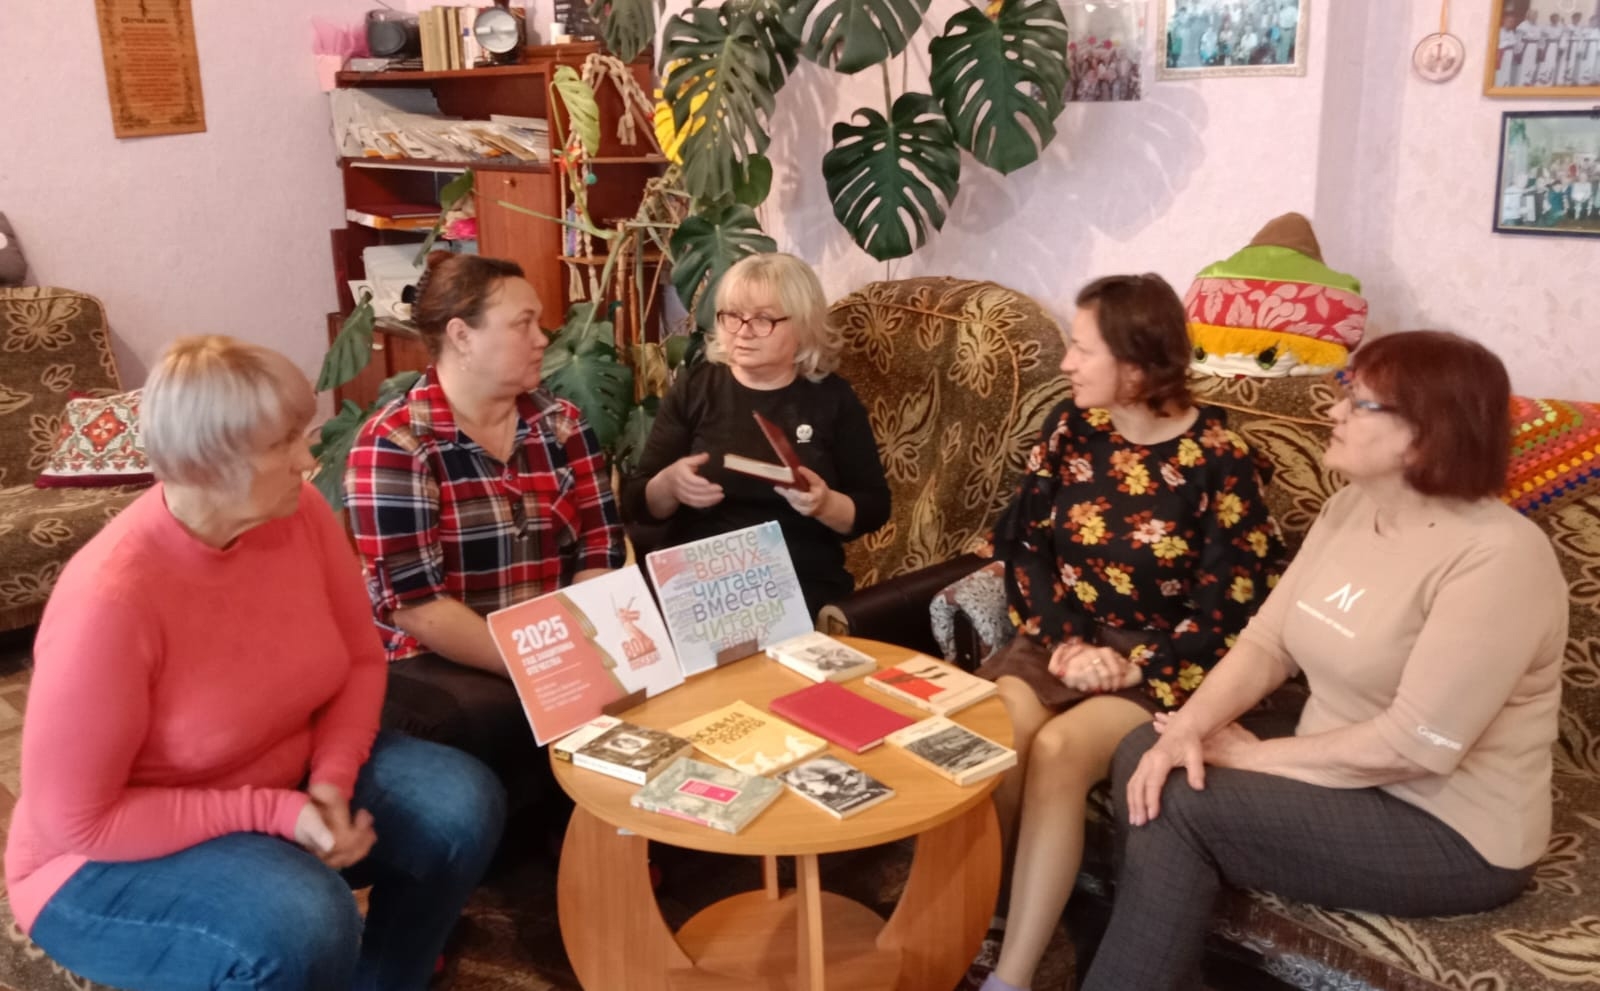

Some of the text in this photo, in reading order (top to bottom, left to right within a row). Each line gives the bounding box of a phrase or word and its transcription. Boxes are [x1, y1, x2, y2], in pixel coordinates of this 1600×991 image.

[684, 530, 758, 562] вместе
[694, 547, 762, 582] вслух
[692, 564, 774, 601] читаем
[692, 580, 779, 623] вместе
[512, 615, 569, 655] 2025
[693, 598, 787, 642] читаем
